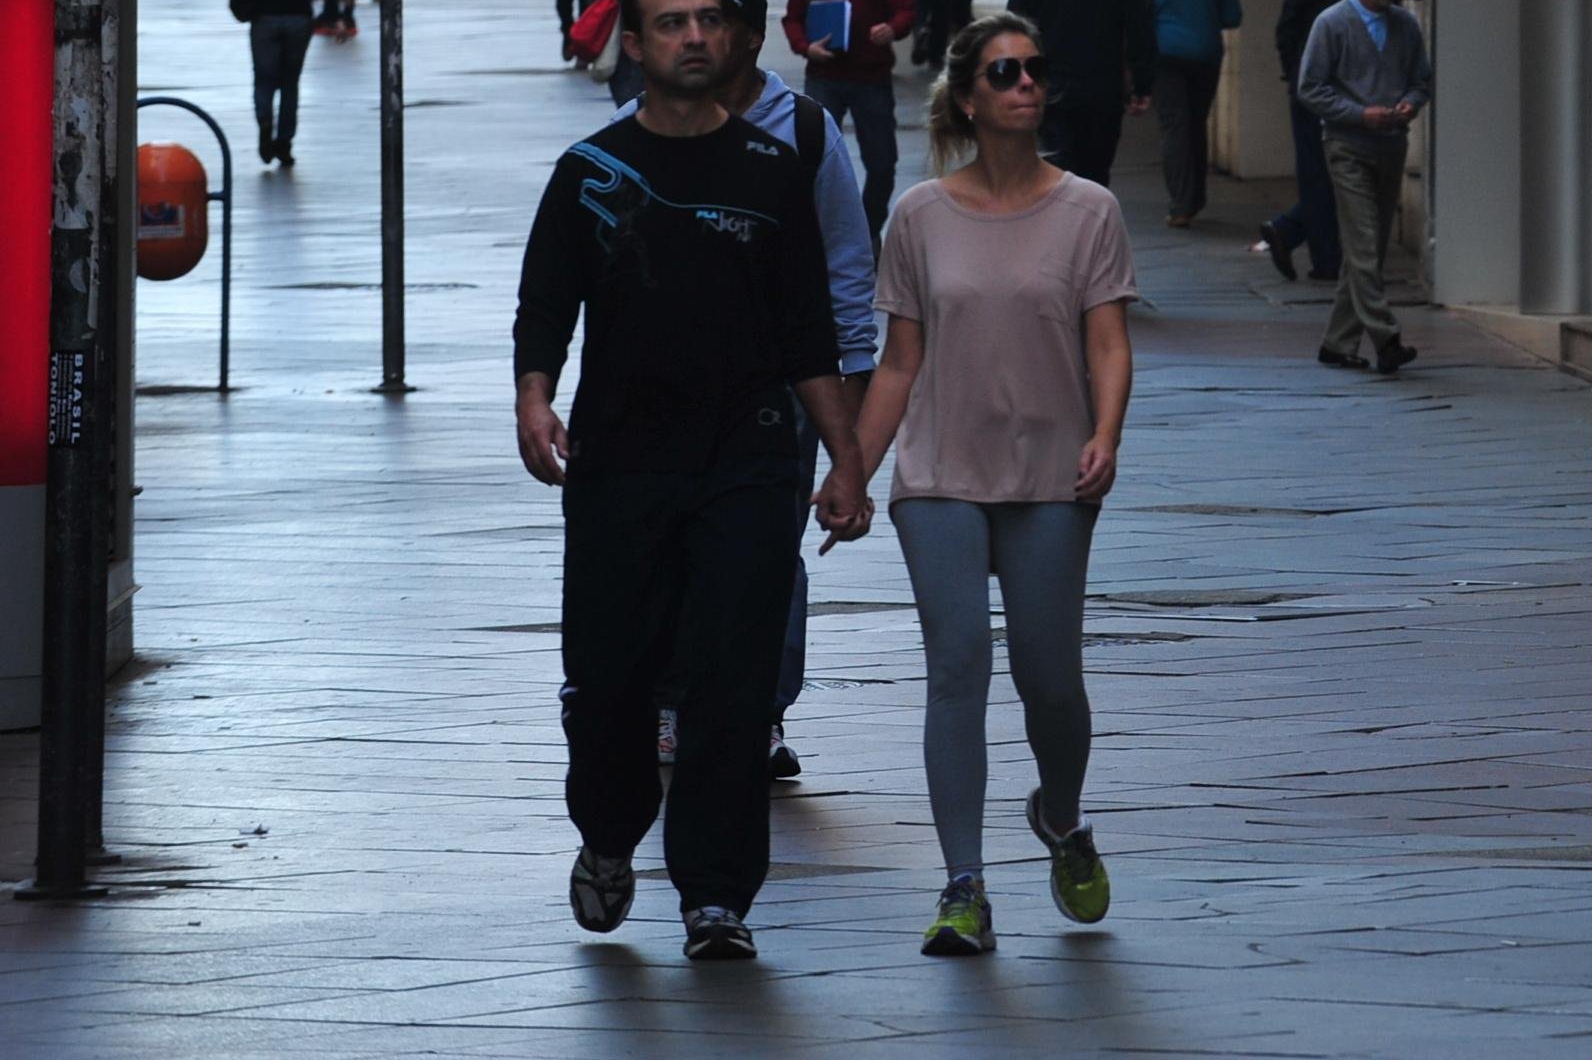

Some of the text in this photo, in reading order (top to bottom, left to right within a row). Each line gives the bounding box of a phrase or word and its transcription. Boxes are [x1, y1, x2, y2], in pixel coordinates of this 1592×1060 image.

[746, 141, 779, 156] FILA
[48, 352, 58, 444] TONIOLO
[71, 353, 83, 444] BRASIL
